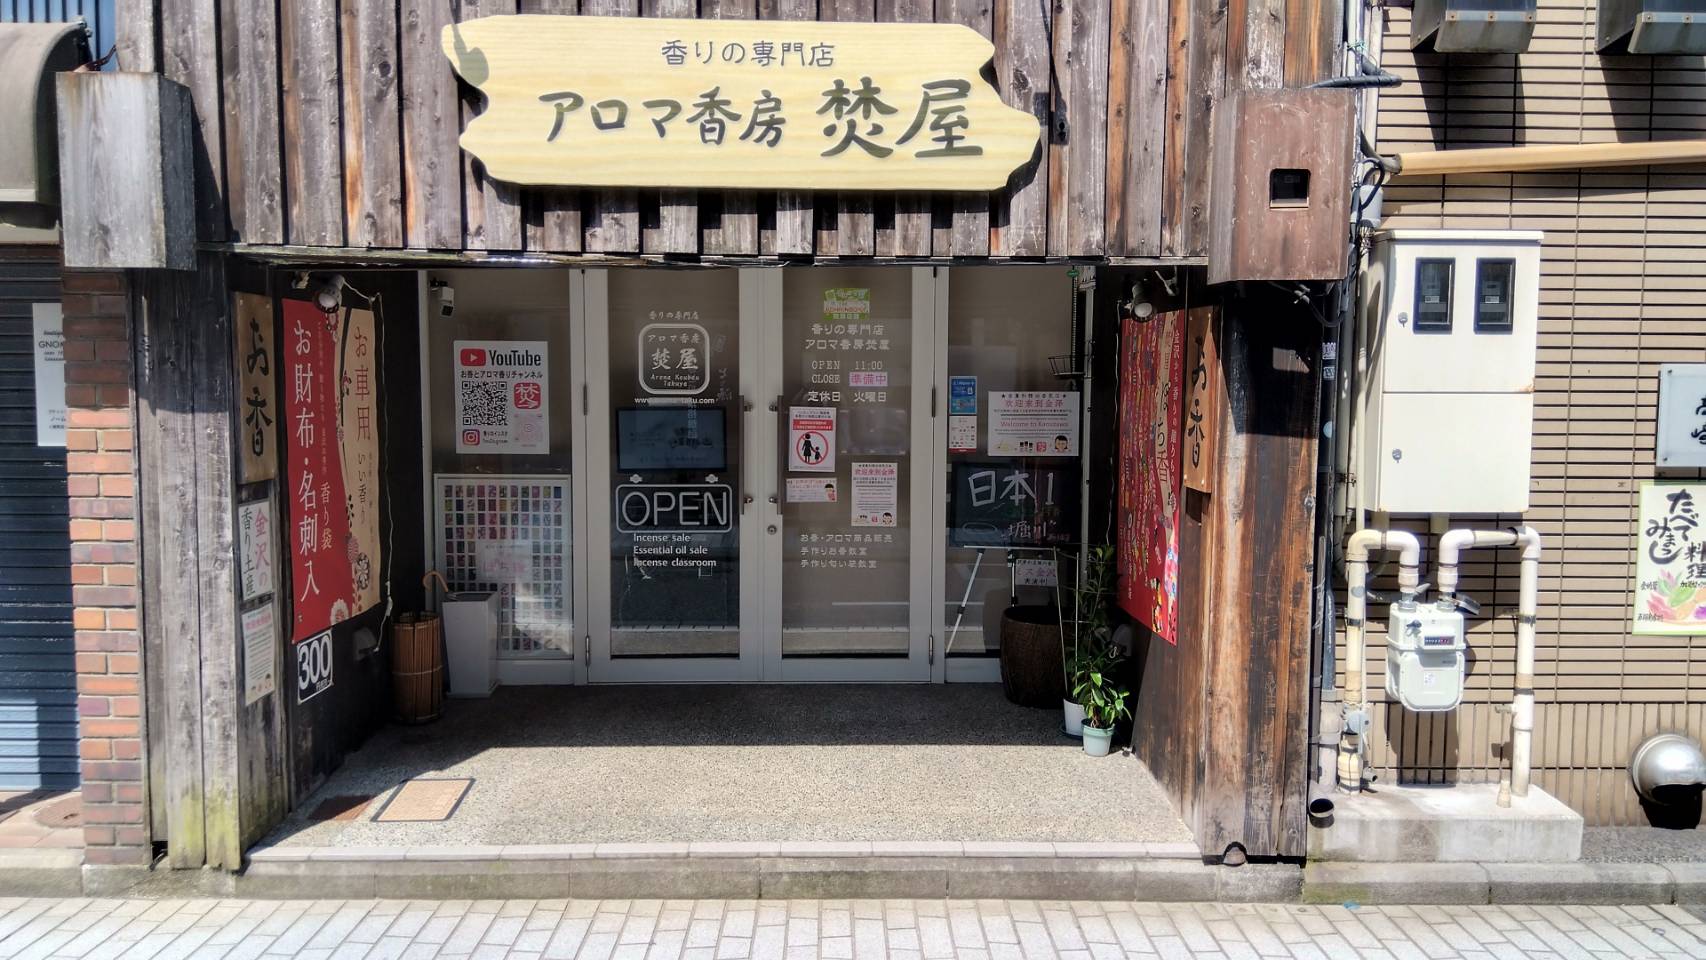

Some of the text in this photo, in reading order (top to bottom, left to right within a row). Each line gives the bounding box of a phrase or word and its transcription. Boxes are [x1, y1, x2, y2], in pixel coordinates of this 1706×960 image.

[661, 39, 835, 68] 香りの専門店
[538, 76, 984, 159] アロマ香房 焚屋
[648, 333, 700, 343] アロマ香房
[811, 323, 885, 336] 香りの専門店
[805, 338, 890, 350] アロマ香房焚屋
[488, 350, 542, 367] YouTube
[651, 347, 699, 370] 焚屋
[811, 360, 883, 371] OPEN 11:00
[246, 318, 273, 458] お香
[354, 326, 371, 441] お車用
[811, 374, 841, 384] CLOSE
[808, 391, 887, 402] 定休日 火曜日
[1187, 335, 1208, 469] お香
[320, 481, 333, 550] 香り袋
[622, 491, 727, 526] OPEN
[1666, 488, 1699, 542] たべて
[633, 533, 691, 542] Incense sale
[633, 545, 708, 554] Essential oil sale
[633, 557, 717, 567] Incense classroom
[299, 634, 331, 690] 300
